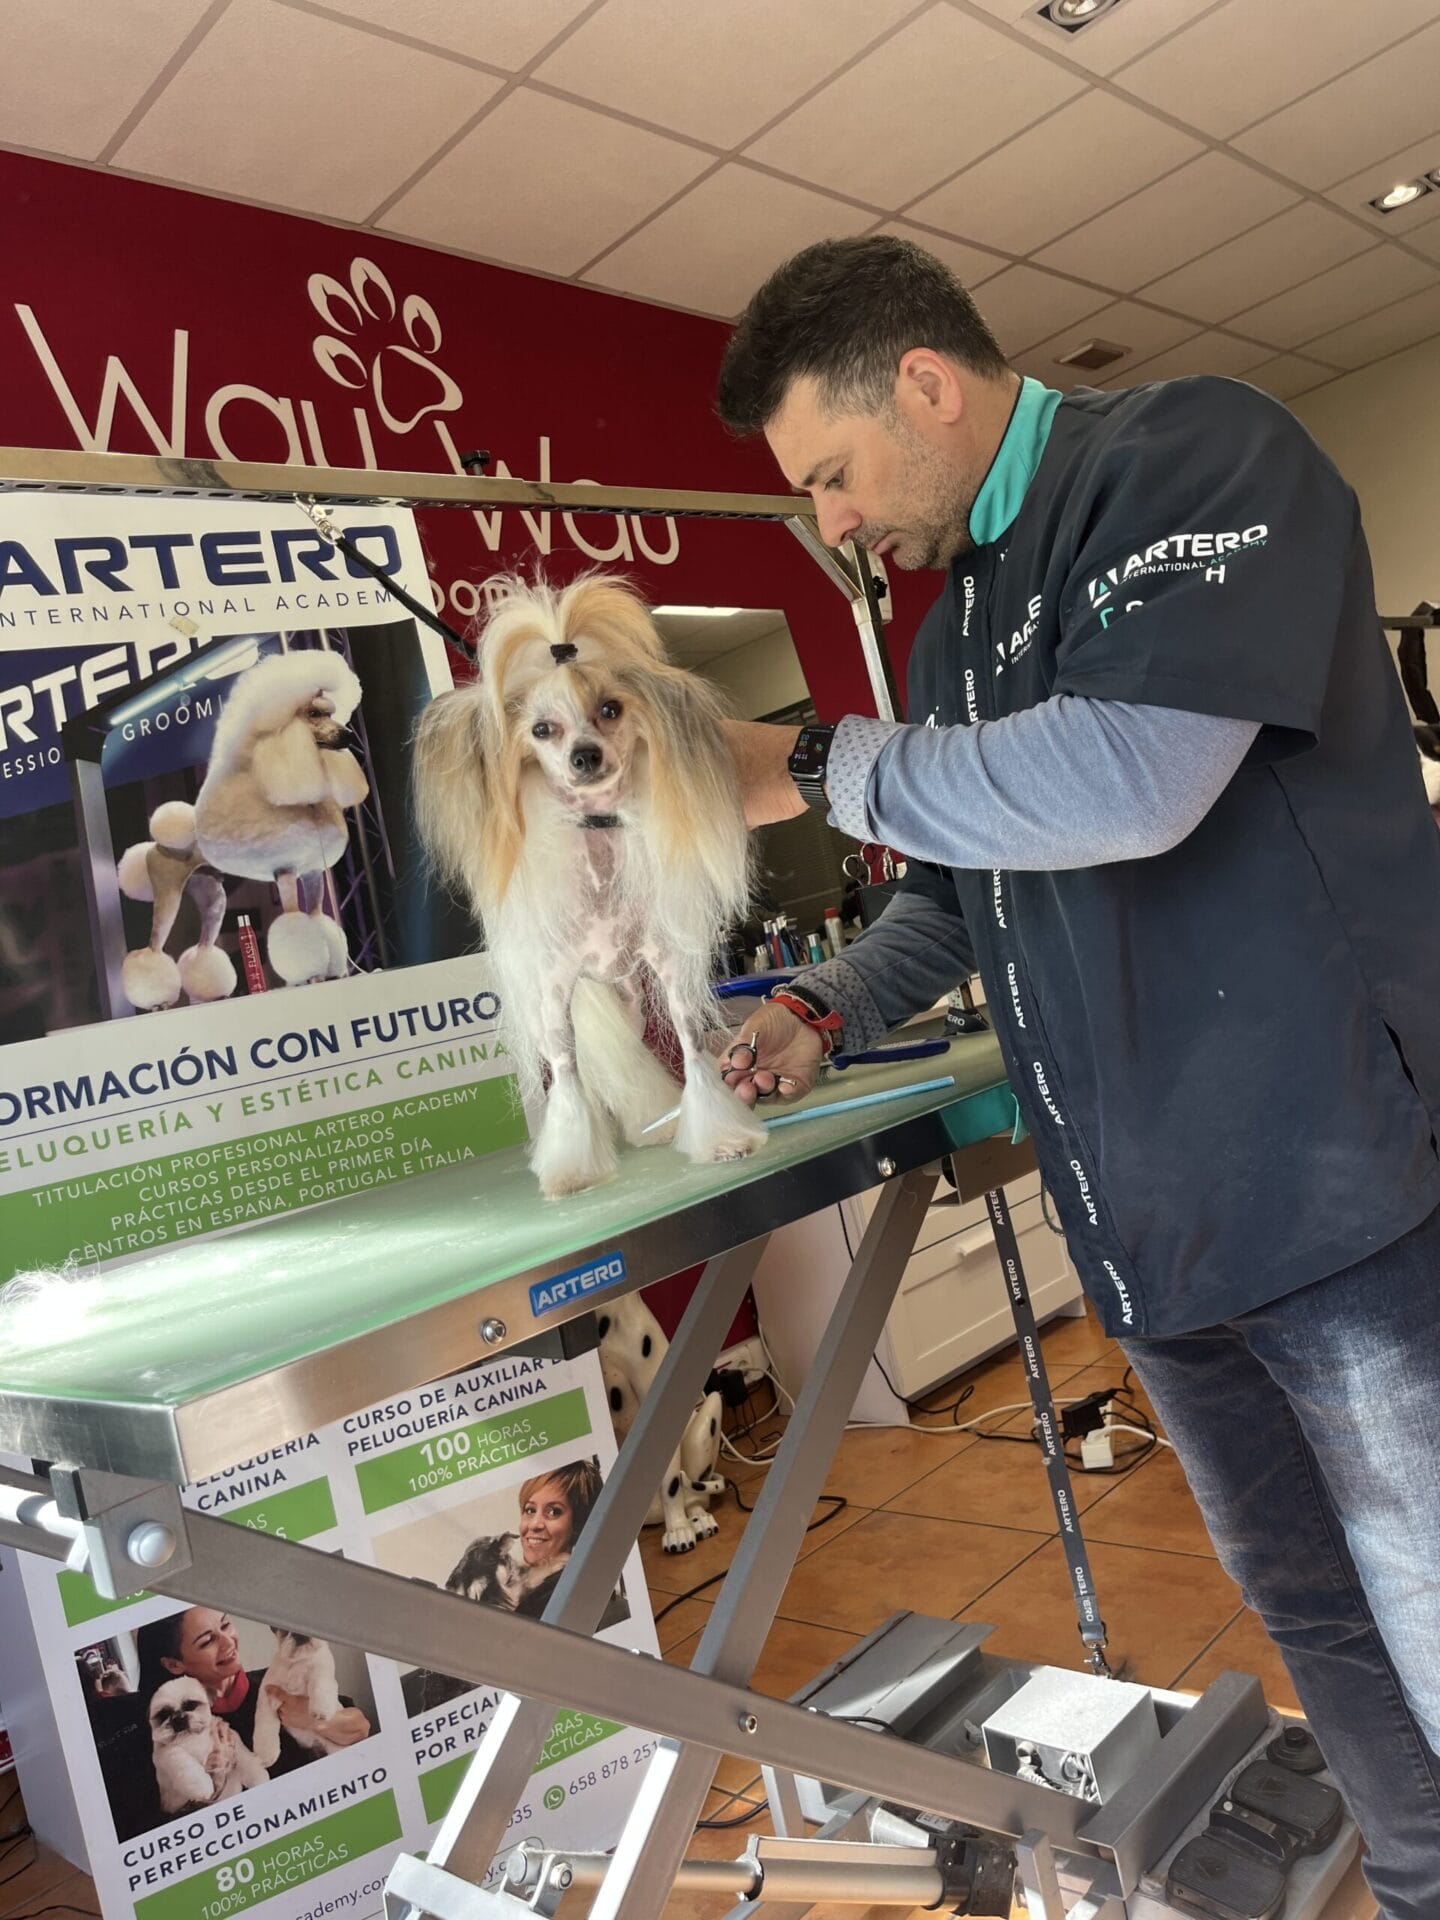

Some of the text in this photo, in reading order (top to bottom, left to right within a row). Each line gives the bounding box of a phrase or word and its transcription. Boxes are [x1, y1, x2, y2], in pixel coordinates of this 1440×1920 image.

[0, 525, 402, 597] ARTERO
[1122, 524, 1268, 580] ARTERO
[0, 597, 256, 628] NTERNATIONAL
[962, 575, 975, 637] ARTERO
[122, 694, 224, 741] GROOMI
[964, 668, 979, 723] RTERO
[947, 1014, 965, 1026] ERO
[1007, 962, 1027, 1029] ARTERO
[0, 991, 501, 1126] ORMACIÓN CON FUTURO
[0, 1040, 509, 1174] ELUQUERÍA Y ESTÉTICA CANINA
[1032, 1061, 1065, 1126] ARTERO
[32, 1087, 478, 1207] TITULACIÓN PROFESIONAL ARTERO ACADEMY
[139, 1127, 395, 1202] CURSOS PERSONALIZADOS
[68, 1146, 475, 1262] CENTROS EN ESPAÑA, PORTUGAL E ITALIA
[111, 1137, 433, 1231] PRÁCTICAS DESDE EL PRIMER DÍA
[989, 1190, 1005, 1226] ARTER
[1070, 1159, 1098, 1226] ARTERO
[537, 1258, 624, 1310] ARTERO
[1103, 1260, 1133, 1326] ARTERO
[1024, 1335, 1040, 1379] ARTERO
[342, 1357, 544, 1435] CURSO DE AUXILIAR
[347, 1378, 547, 1457] PELUQUERÍA CANINA
[408, 1431, 549, 1492] 100% PRÁCTICAS
[420, 1418, 532, 1467] 100 HORAS
[1040, 1412, 1057, 1456] ARTERO
[197, 1468, 287, 1511] CANINA
[1057, 1489, 1074, 1533] ARTERO
[1074, 1566, 1088, 1596] TERO
[1082, 1600, 1095, 1622] ERO
[415, 1736, 457, 1766] POR
[569, 1772, 597, 1795] 658
[602, 1756, 629, 1779] 878
[122, 1804, 247, 1868] CURSO DE
[128, 1767, 388, 1892] PERFECCIONAMIENTO
[202, 1844, 349, 1920] 100% PRÁCTICAS
[215, 1835, 325, 1892] 80 HORAS
